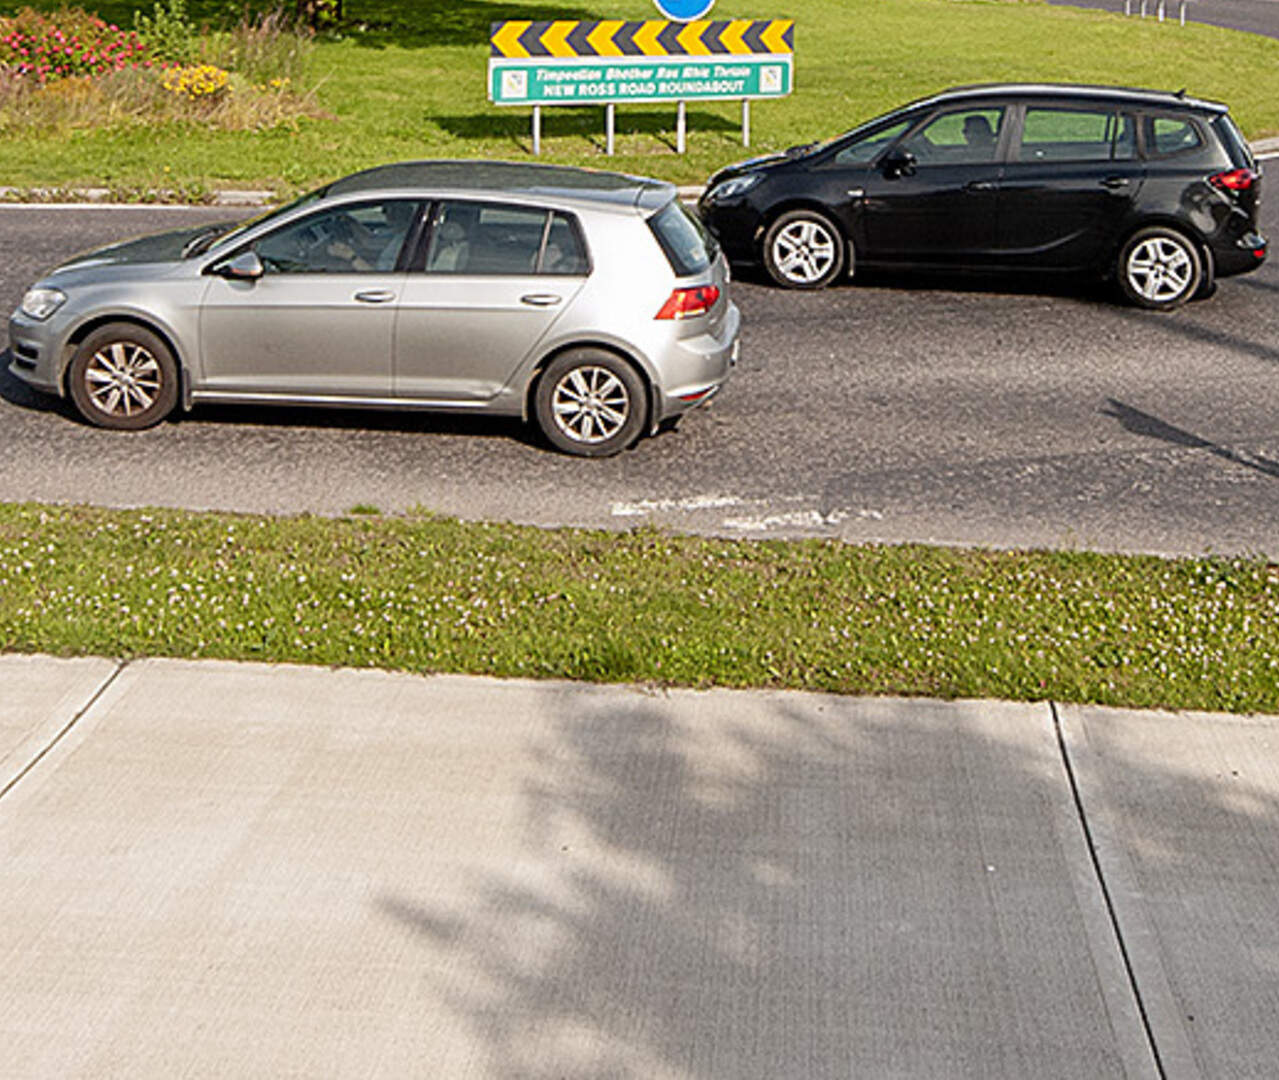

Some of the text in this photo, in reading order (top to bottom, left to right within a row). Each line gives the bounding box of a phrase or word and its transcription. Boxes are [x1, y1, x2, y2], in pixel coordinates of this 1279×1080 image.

[543, 79, 745, 97] NEW ROSS ROAD ROUNDABOUT
